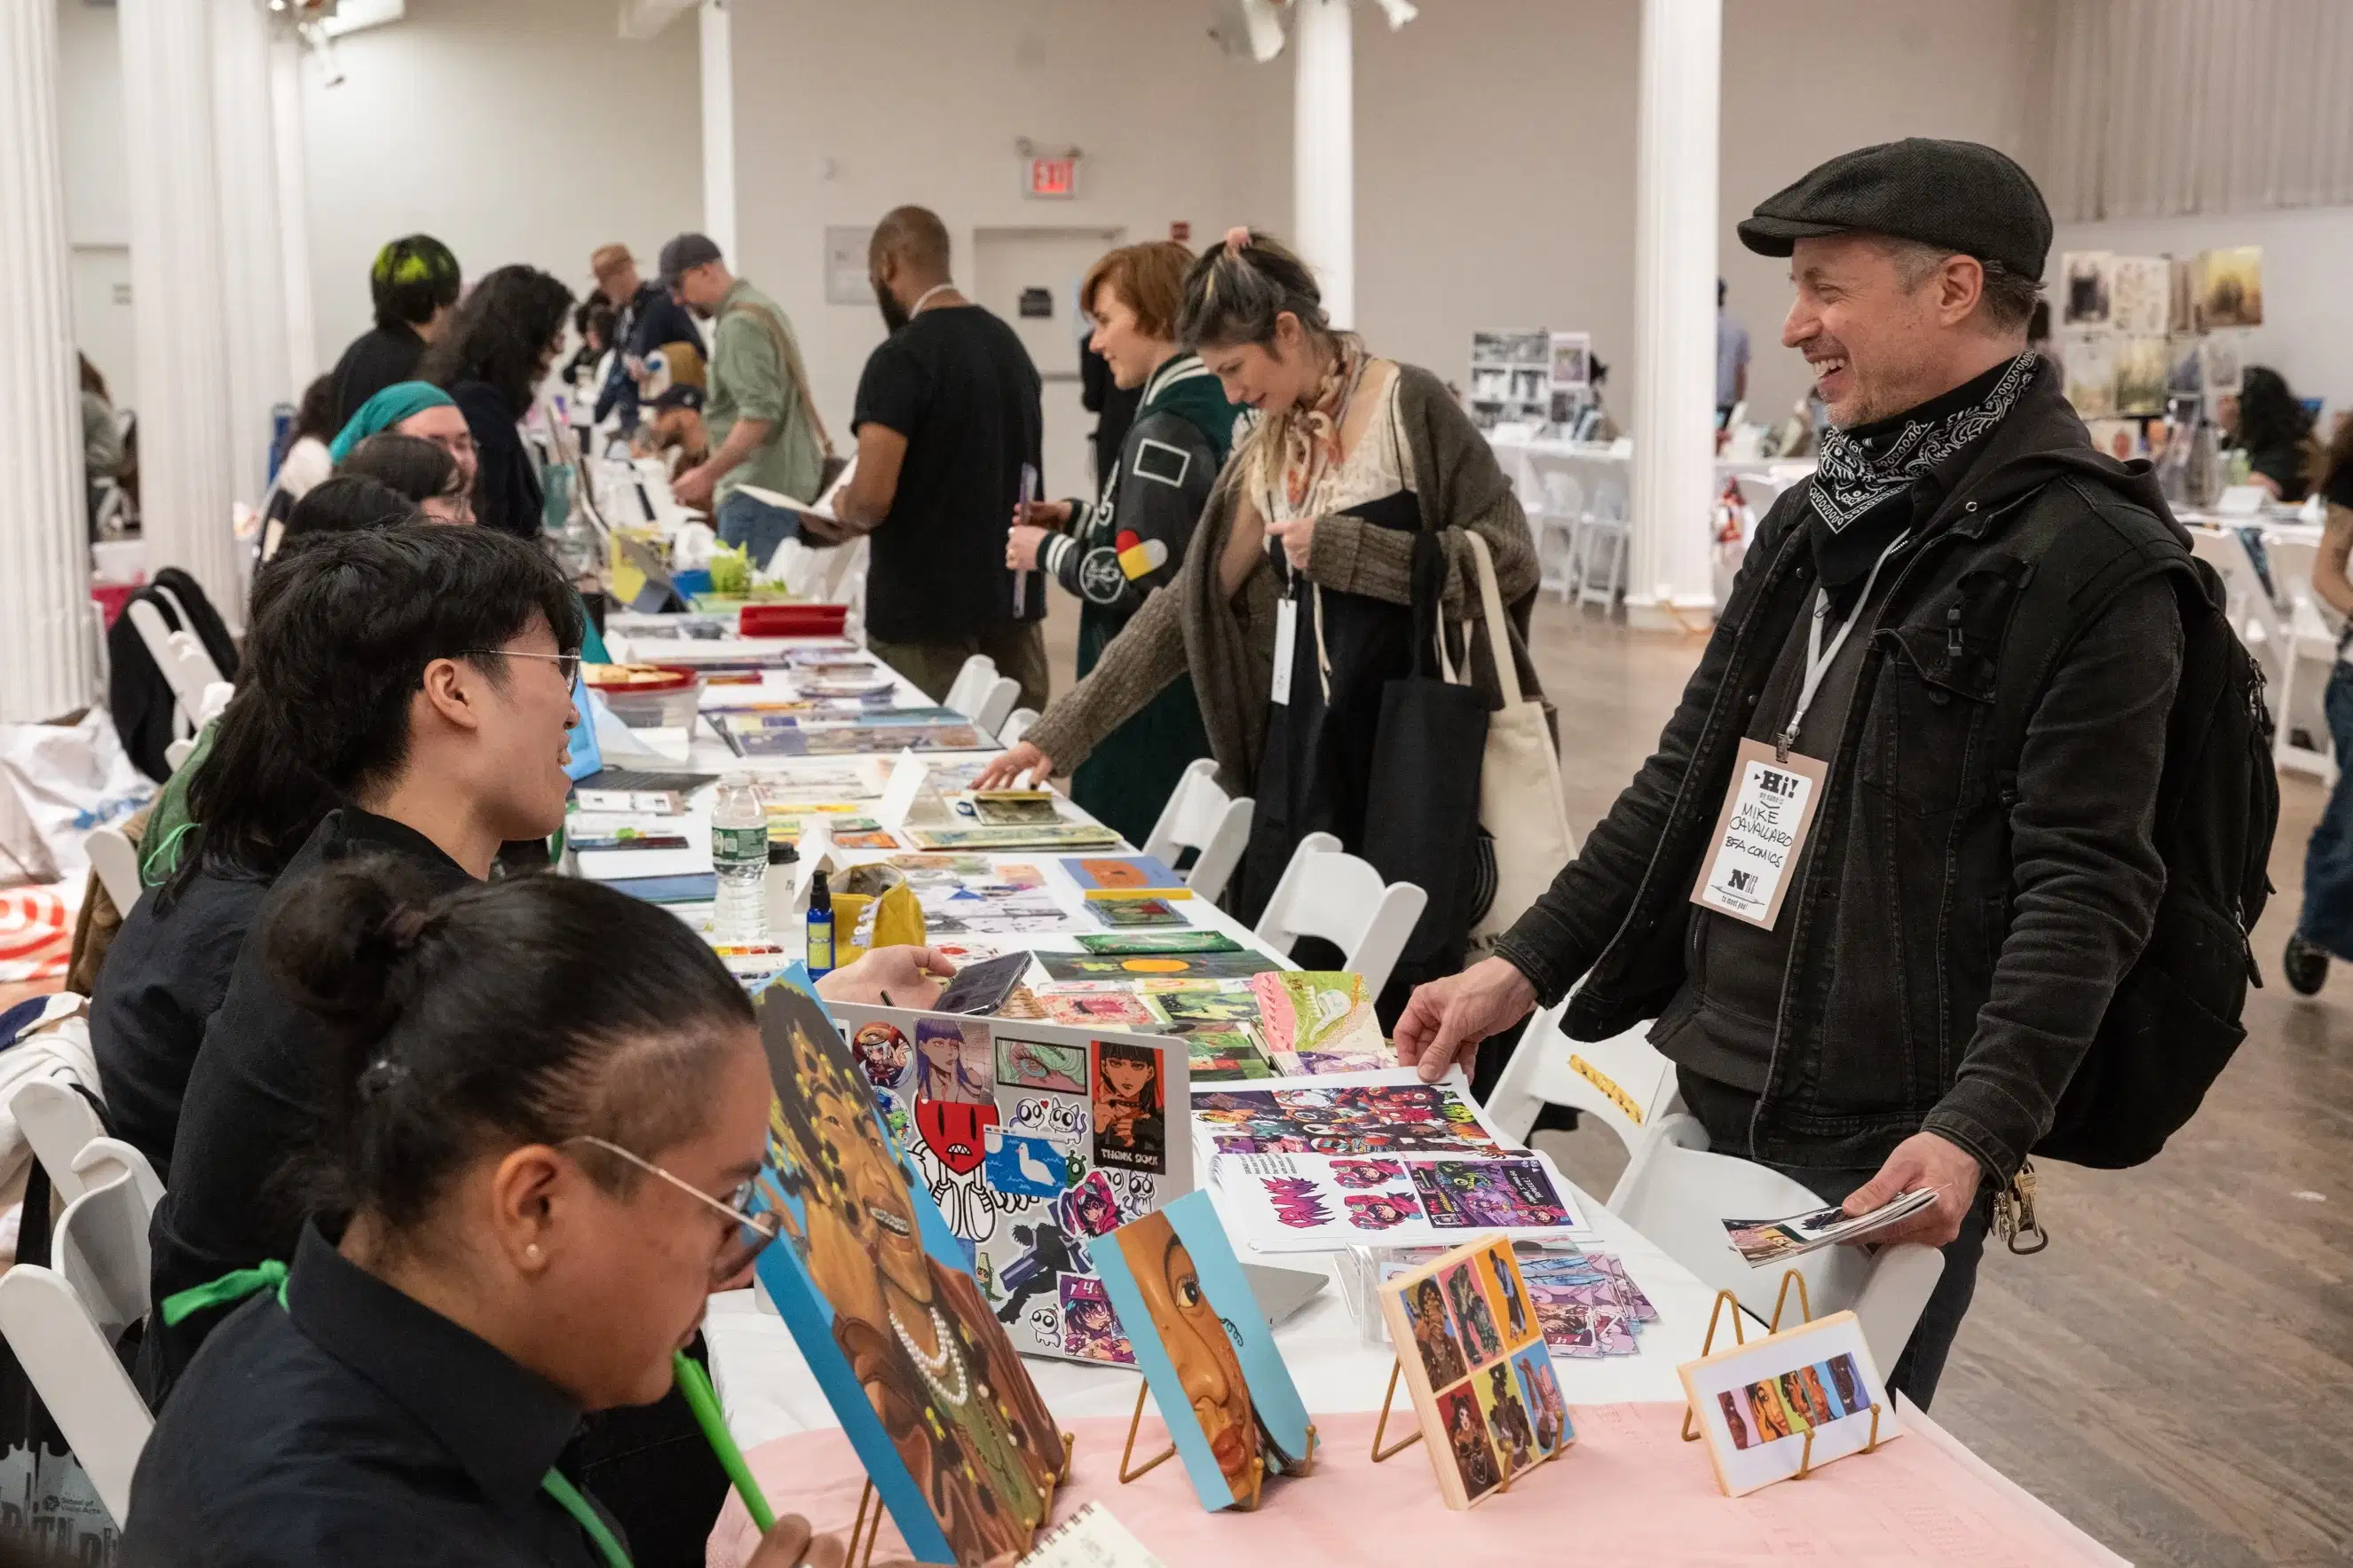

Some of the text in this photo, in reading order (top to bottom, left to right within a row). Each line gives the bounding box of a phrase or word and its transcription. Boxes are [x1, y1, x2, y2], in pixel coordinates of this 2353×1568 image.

[1760, 769, 1799, 799] Hi!
[1766, 793, 1779, 803] name
[1742, 803, 1779, 824] MIKE
[1729, 816, 1792, 847] CAVALLARO
[1725, 837, 1783, 868] BFA COMICS
[1727, 896, 1738, 907] meet
[1738, 900, 1749, 911] you!
